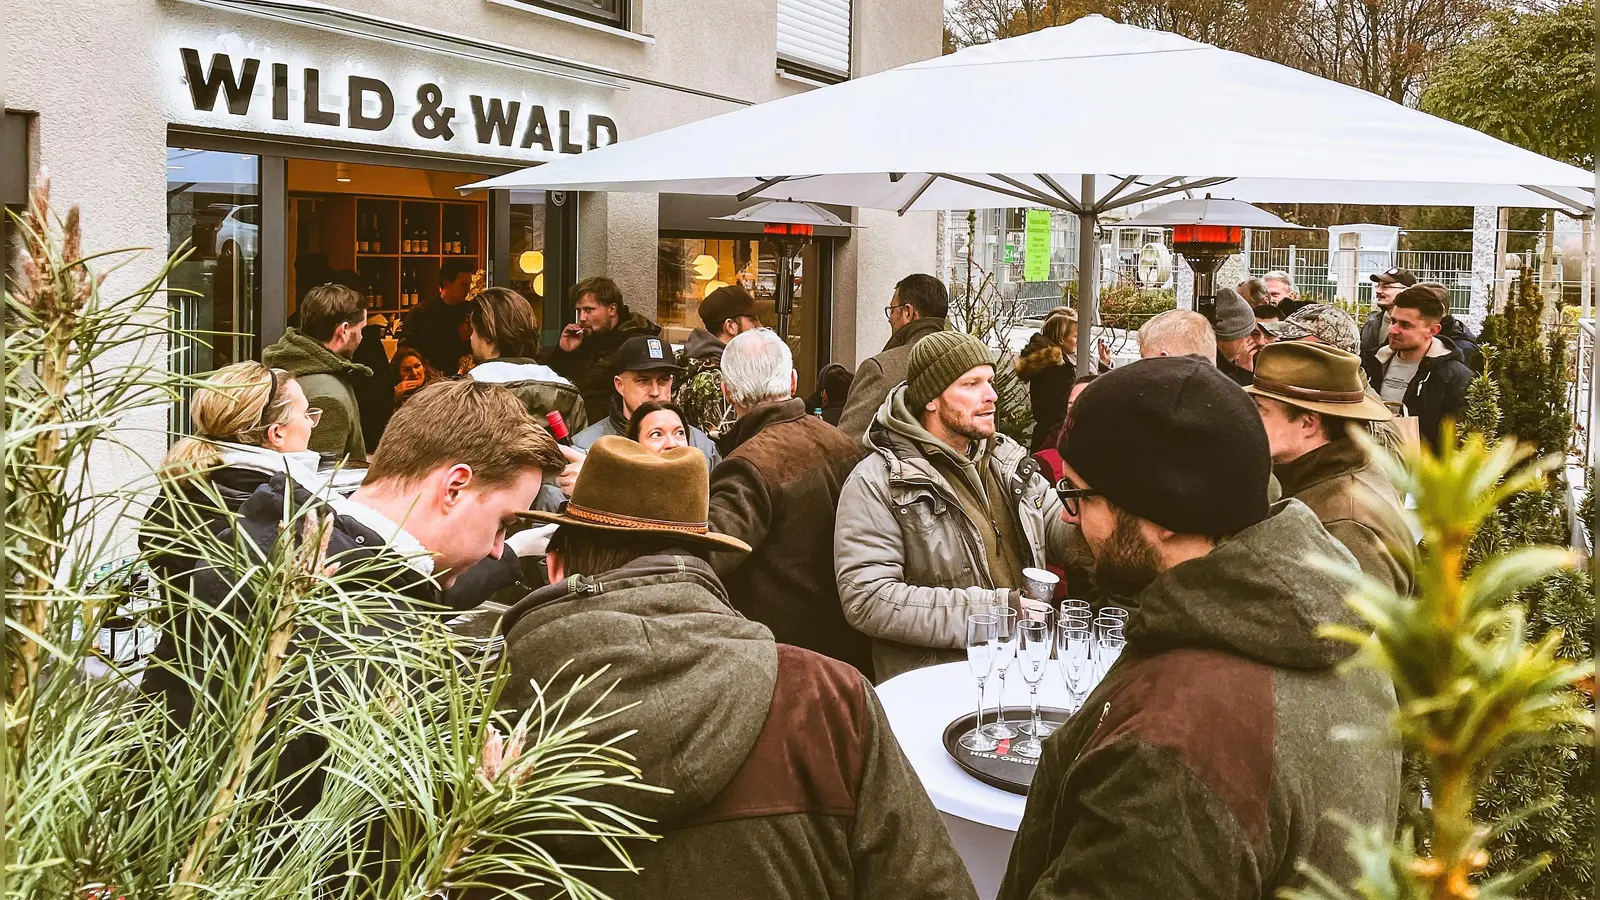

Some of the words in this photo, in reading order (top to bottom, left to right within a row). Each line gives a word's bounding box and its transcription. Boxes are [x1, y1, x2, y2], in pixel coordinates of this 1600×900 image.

[179, 47, 395, 131] WILD
[412, 83, 455, 141] &
[469, 95, 618, 154] WALD
[970, 751, 998, 759] HIER
